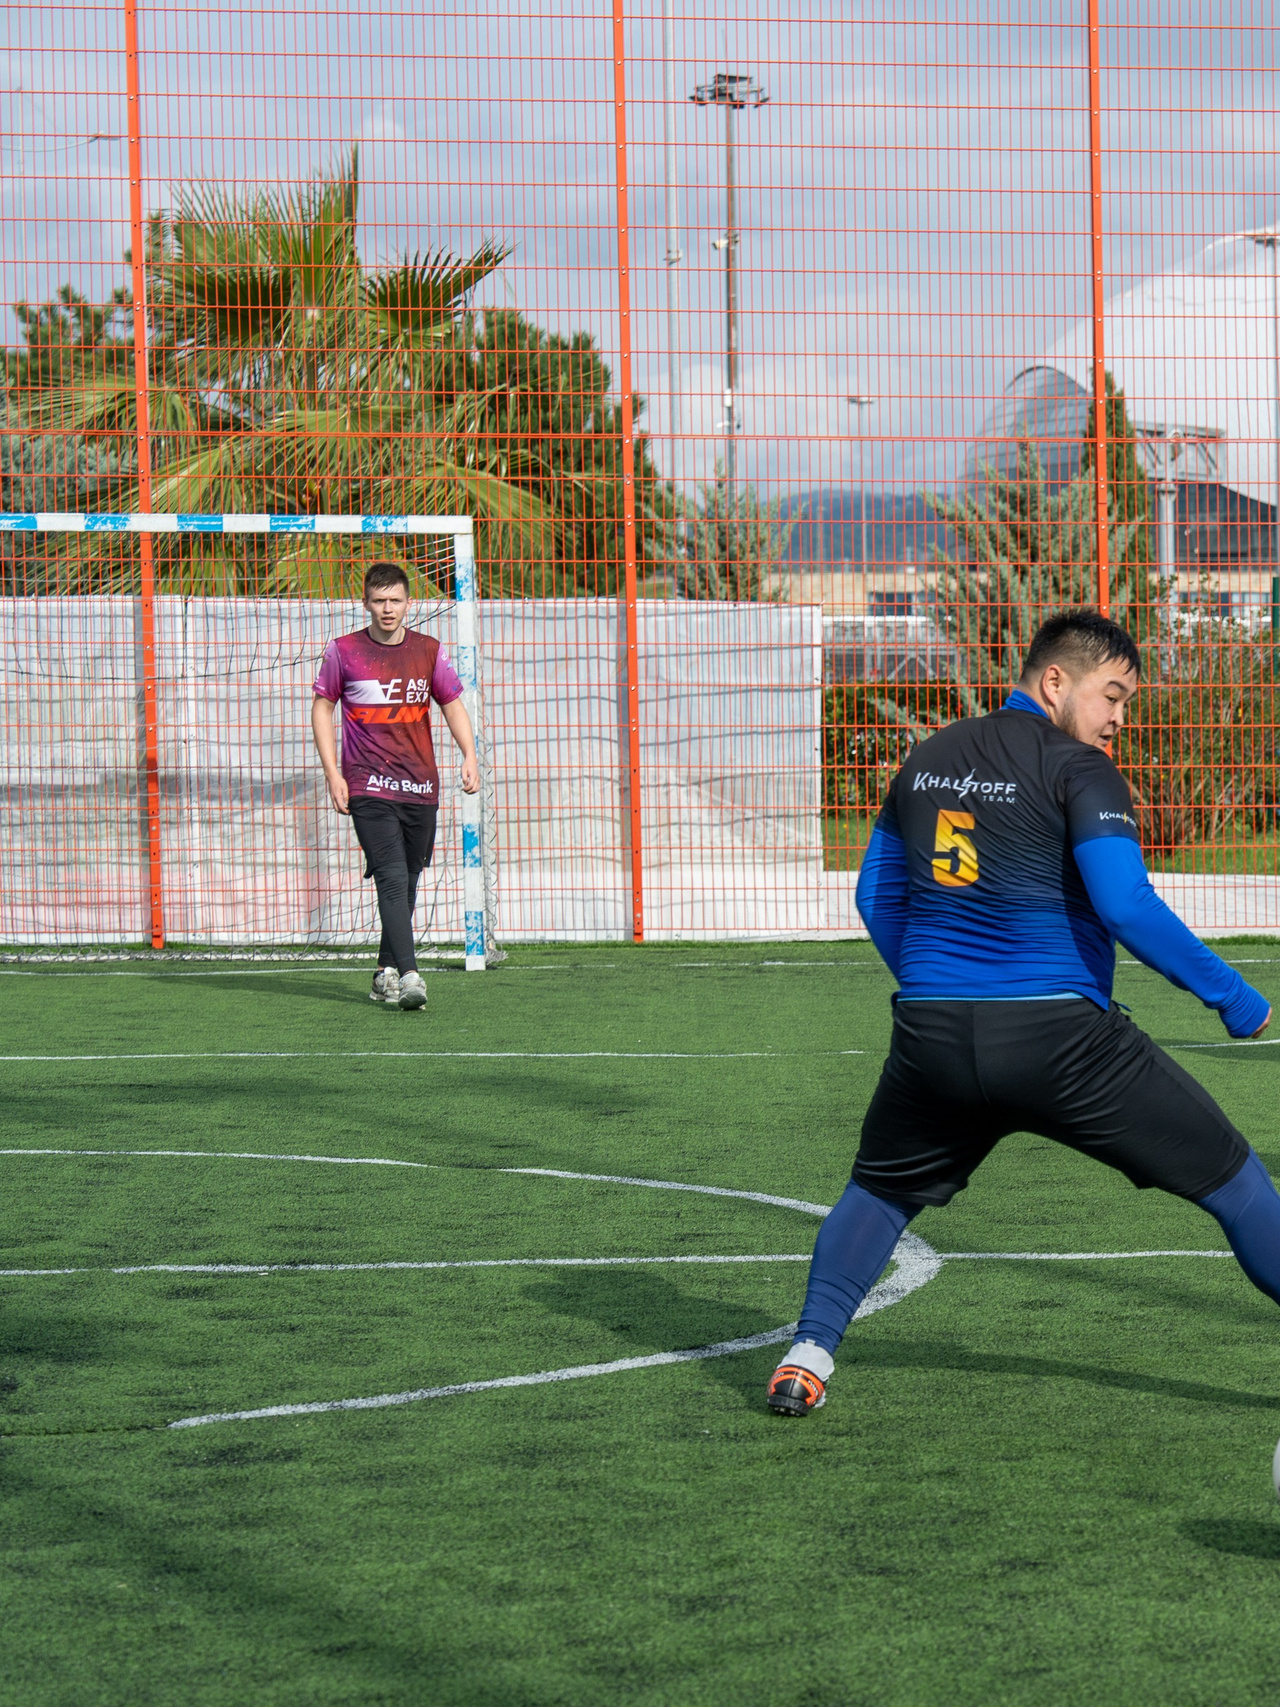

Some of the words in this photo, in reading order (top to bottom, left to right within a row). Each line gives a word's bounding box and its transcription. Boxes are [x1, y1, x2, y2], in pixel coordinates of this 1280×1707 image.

[366, 774, 400, 792] Alfa
[401, 779, 434, 794] Bank
[982, 795, 1016, 805] TEAM
[931, 808, 980, 887] 5
